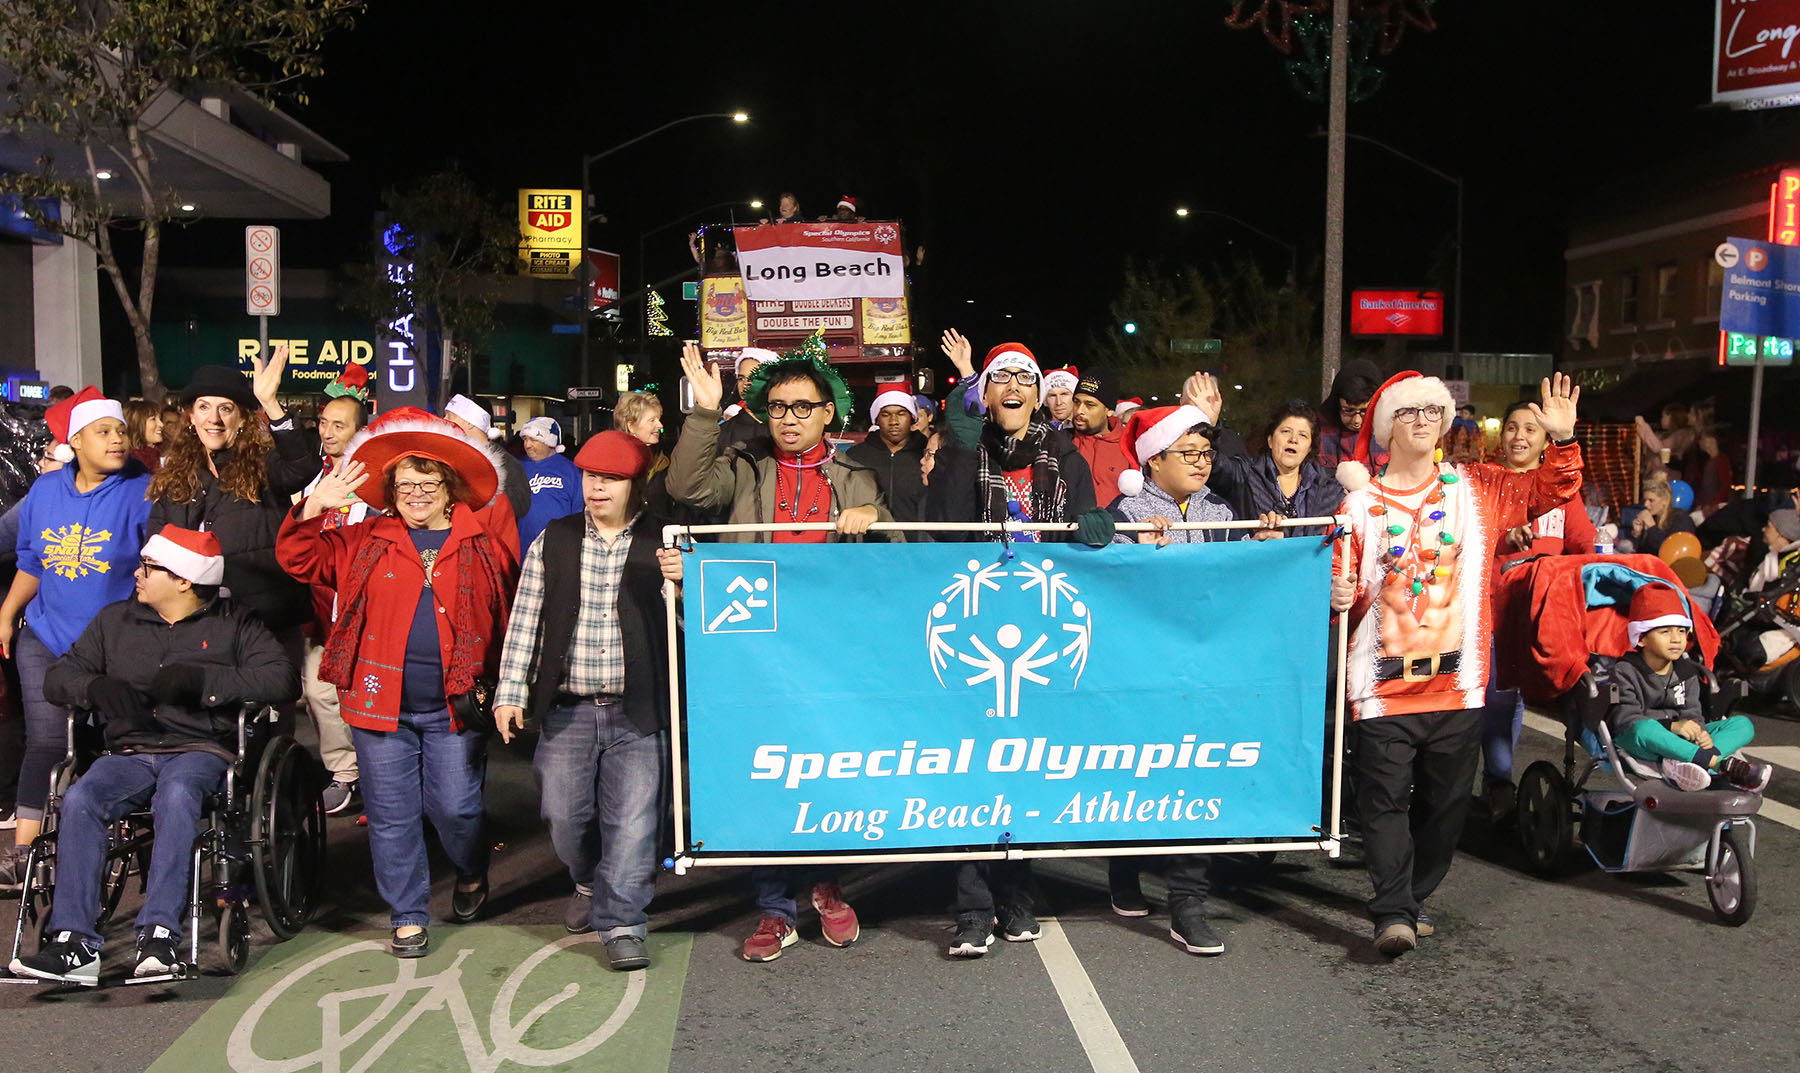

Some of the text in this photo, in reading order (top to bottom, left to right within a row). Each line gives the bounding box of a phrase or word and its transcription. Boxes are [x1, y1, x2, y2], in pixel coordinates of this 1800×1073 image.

[1726, 8, 1800, 58] Long
[534, 196, 566, 208] RITE
[1781, 176, 1800, 245] PIZ
[536, 213, 565, 227] AID
[527, 235, 573, 243] Pharmacy
[746, 257, 891, 283] Long Beach
[1730, 274, 1771, 288] Belmont
[1361, 299, 1437, 310] Bank of America
[1729, 290, 1767, 306] Parking
[763, 318, 800, 328] DOUBLE
[802, 317, 820, 327] THE
[823, 317, 841, 326] FUN
[706, 327, 718, 335] Big
[719, 327, 733, 335] Red
[238, 339, 374, 364] RTE AID
[292, 369, 340, 379] Foodmart
[20, 385, 43, 398] CHASE
[529, 473, 563, 494] dgers
[750, 734, 1262, 789] Special Olympics
[791, 801, 889, 841] Long
[897, 794, 1012, 831] Beach
[1053, 789, 1223, 825] Athletics
